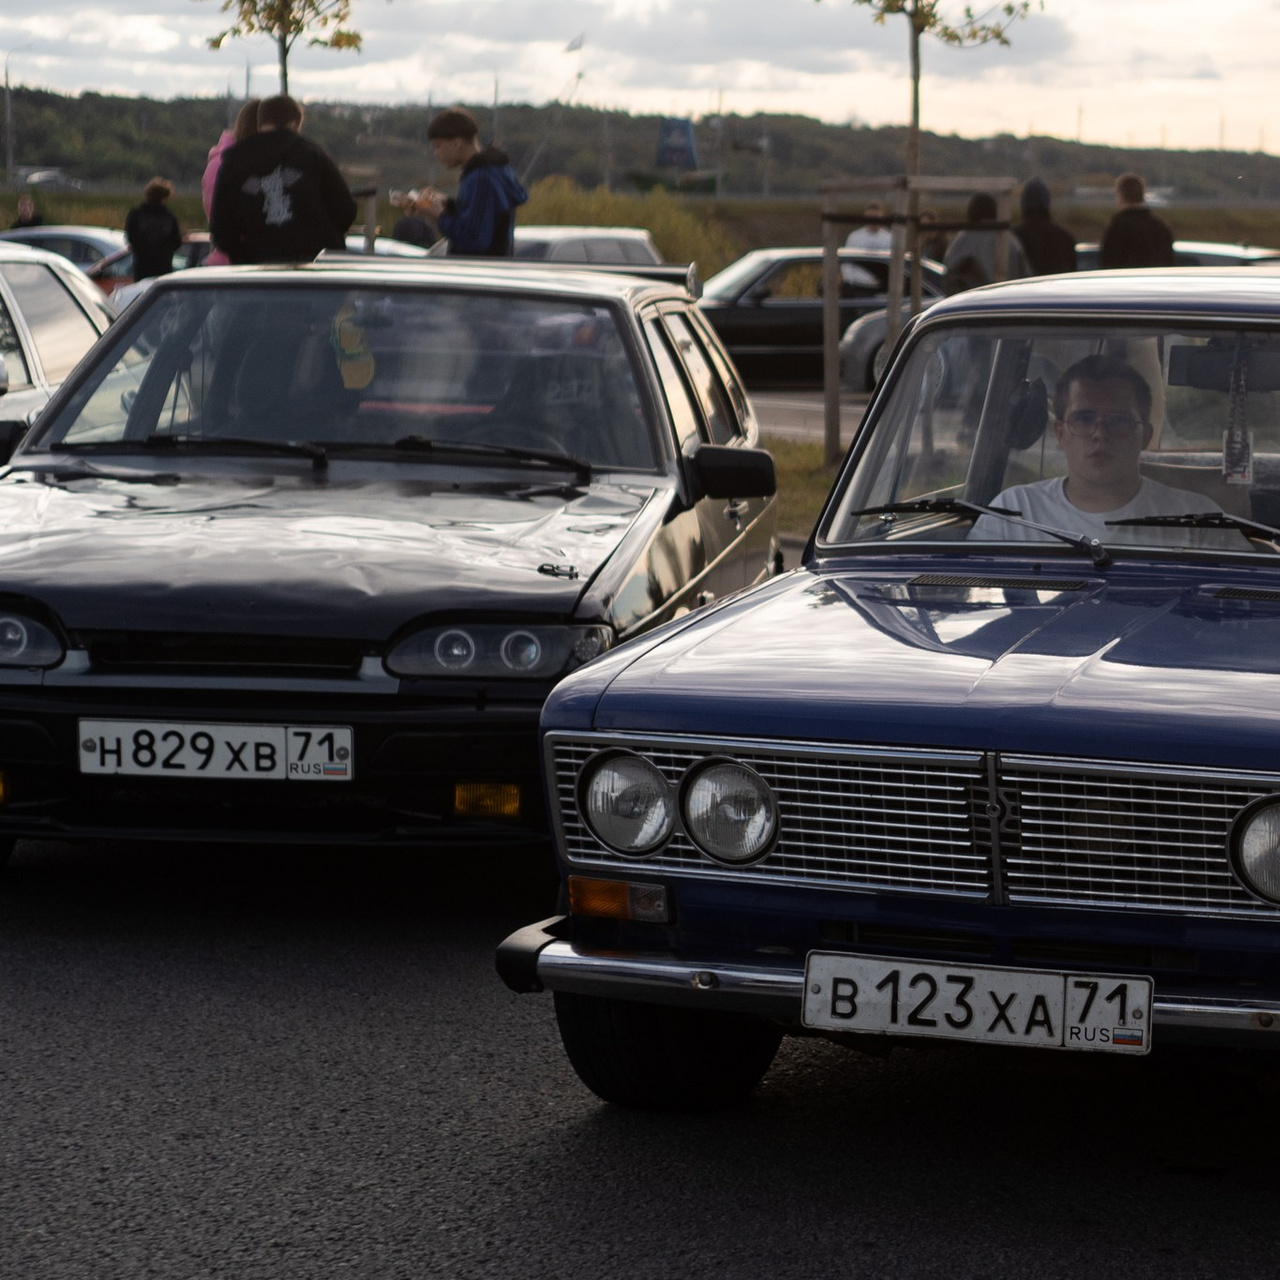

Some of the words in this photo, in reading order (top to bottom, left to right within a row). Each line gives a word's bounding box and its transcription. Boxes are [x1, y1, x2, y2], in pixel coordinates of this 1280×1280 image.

[292, 731, 336, 762] 71
[289, 762, 322, 776] RUS
[1072, 980, 1130, 1026] 71
[1069, 1025, 1111, 1044] RUS
